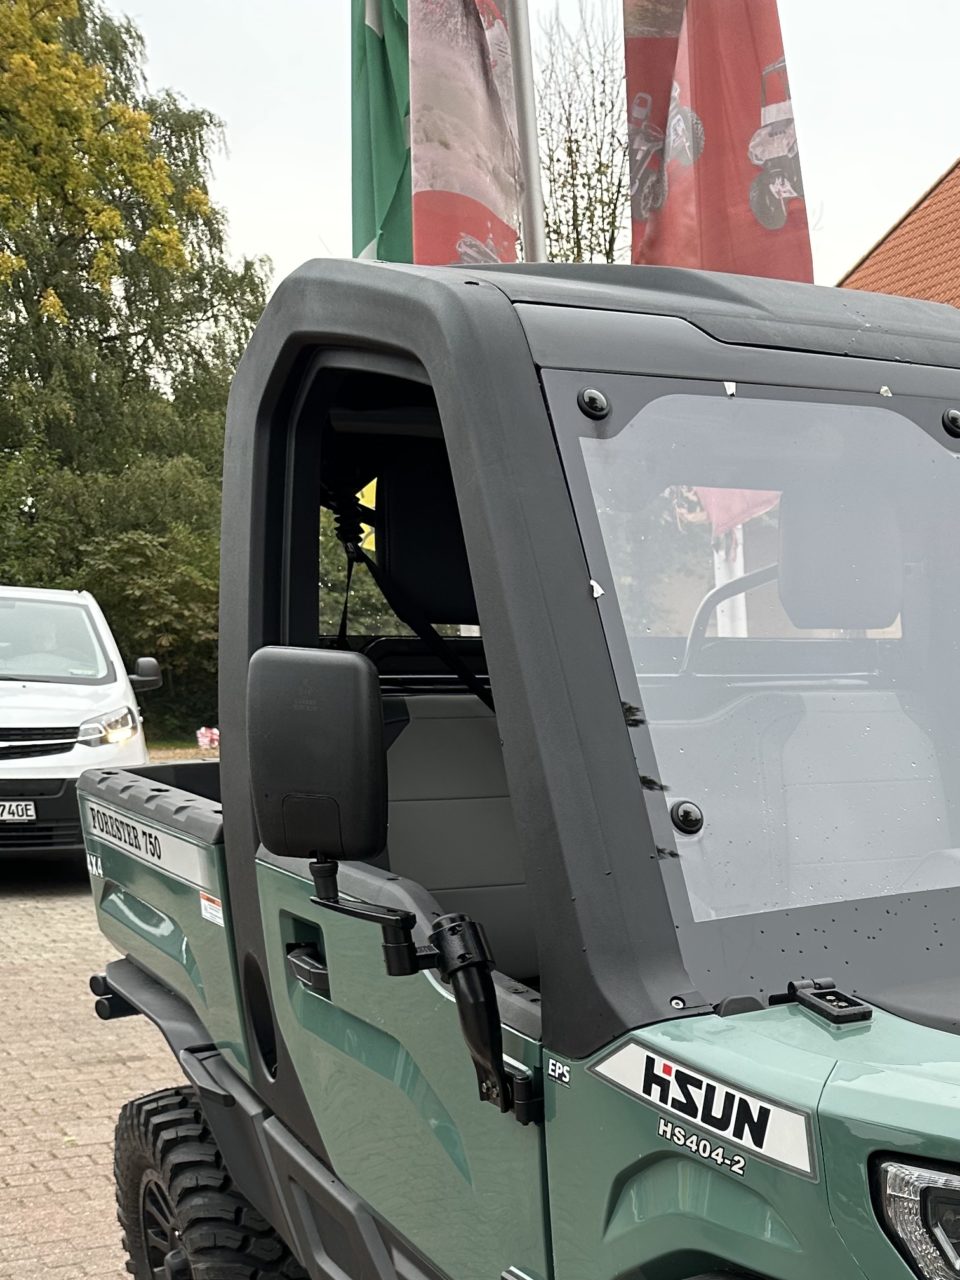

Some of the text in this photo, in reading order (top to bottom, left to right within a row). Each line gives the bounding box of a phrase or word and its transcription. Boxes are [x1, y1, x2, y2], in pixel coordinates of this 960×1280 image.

[90, 807, 162, 860] FORESTER 750
[548, 1058, 570, 1083] EPS
[642, 1054, 771, 1149] HSUN
[658, 1117, 747, 1176] HS404-2
